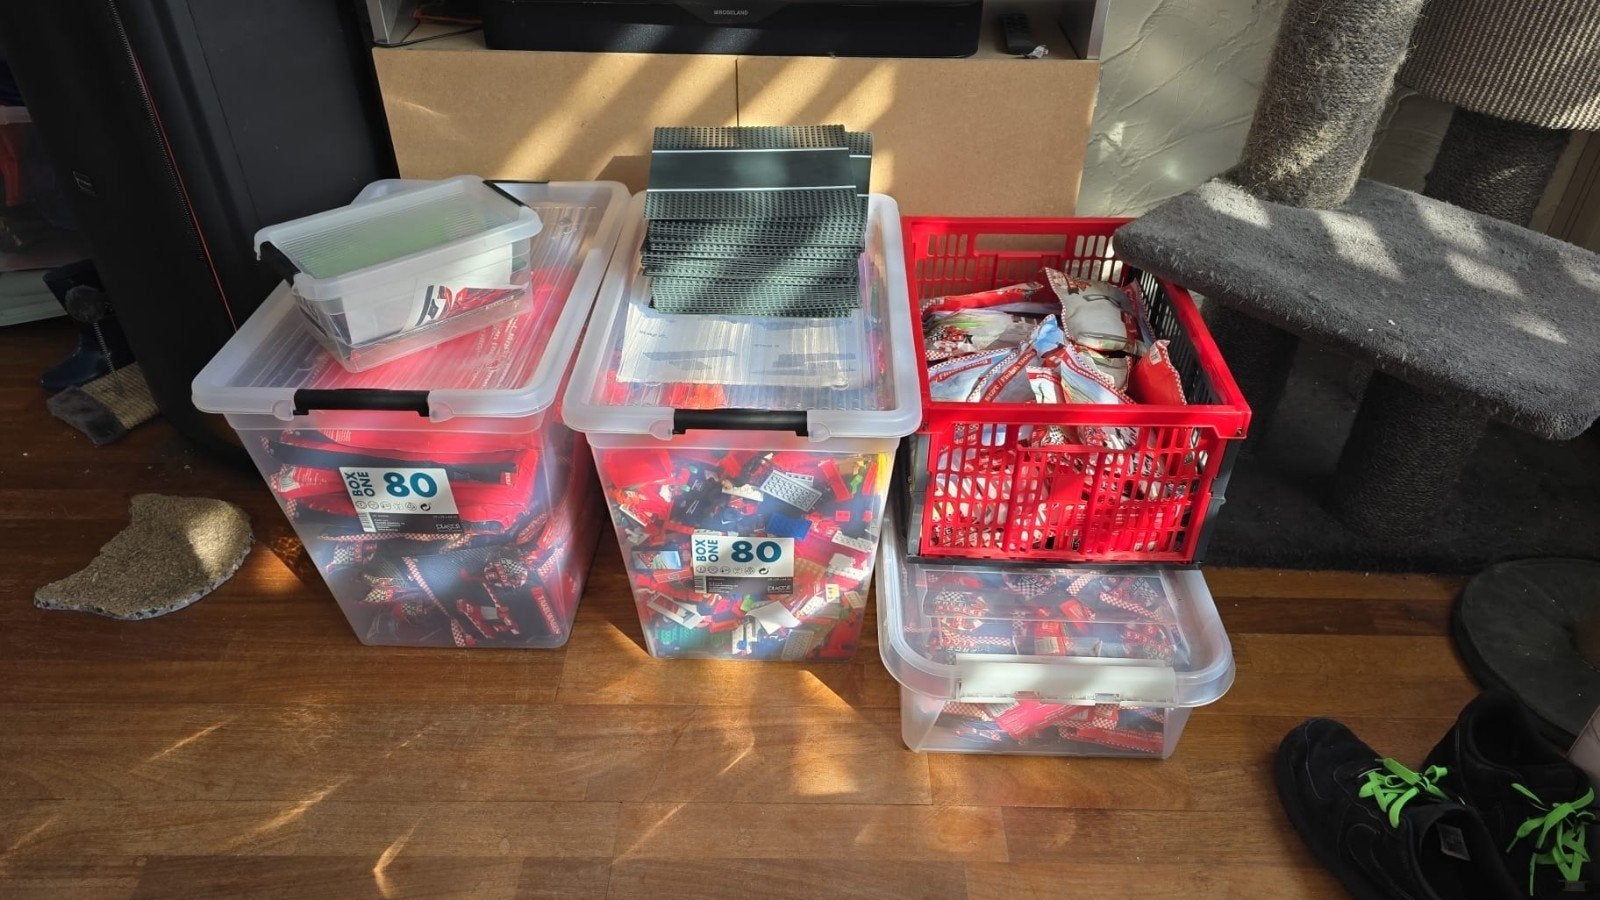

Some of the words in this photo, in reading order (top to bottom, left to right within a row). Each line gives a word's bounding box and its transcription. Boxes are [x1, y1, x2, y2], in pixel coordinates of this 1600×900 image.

[344, 471, 364, 497] BOX
[357, 472, 375, 497] ONE
[383, 472, 438, 498] 80
[695, 539, 706, 562] BOX
[708, 539, 719, 562] ONE
[731, 540, 782, 563] 80
